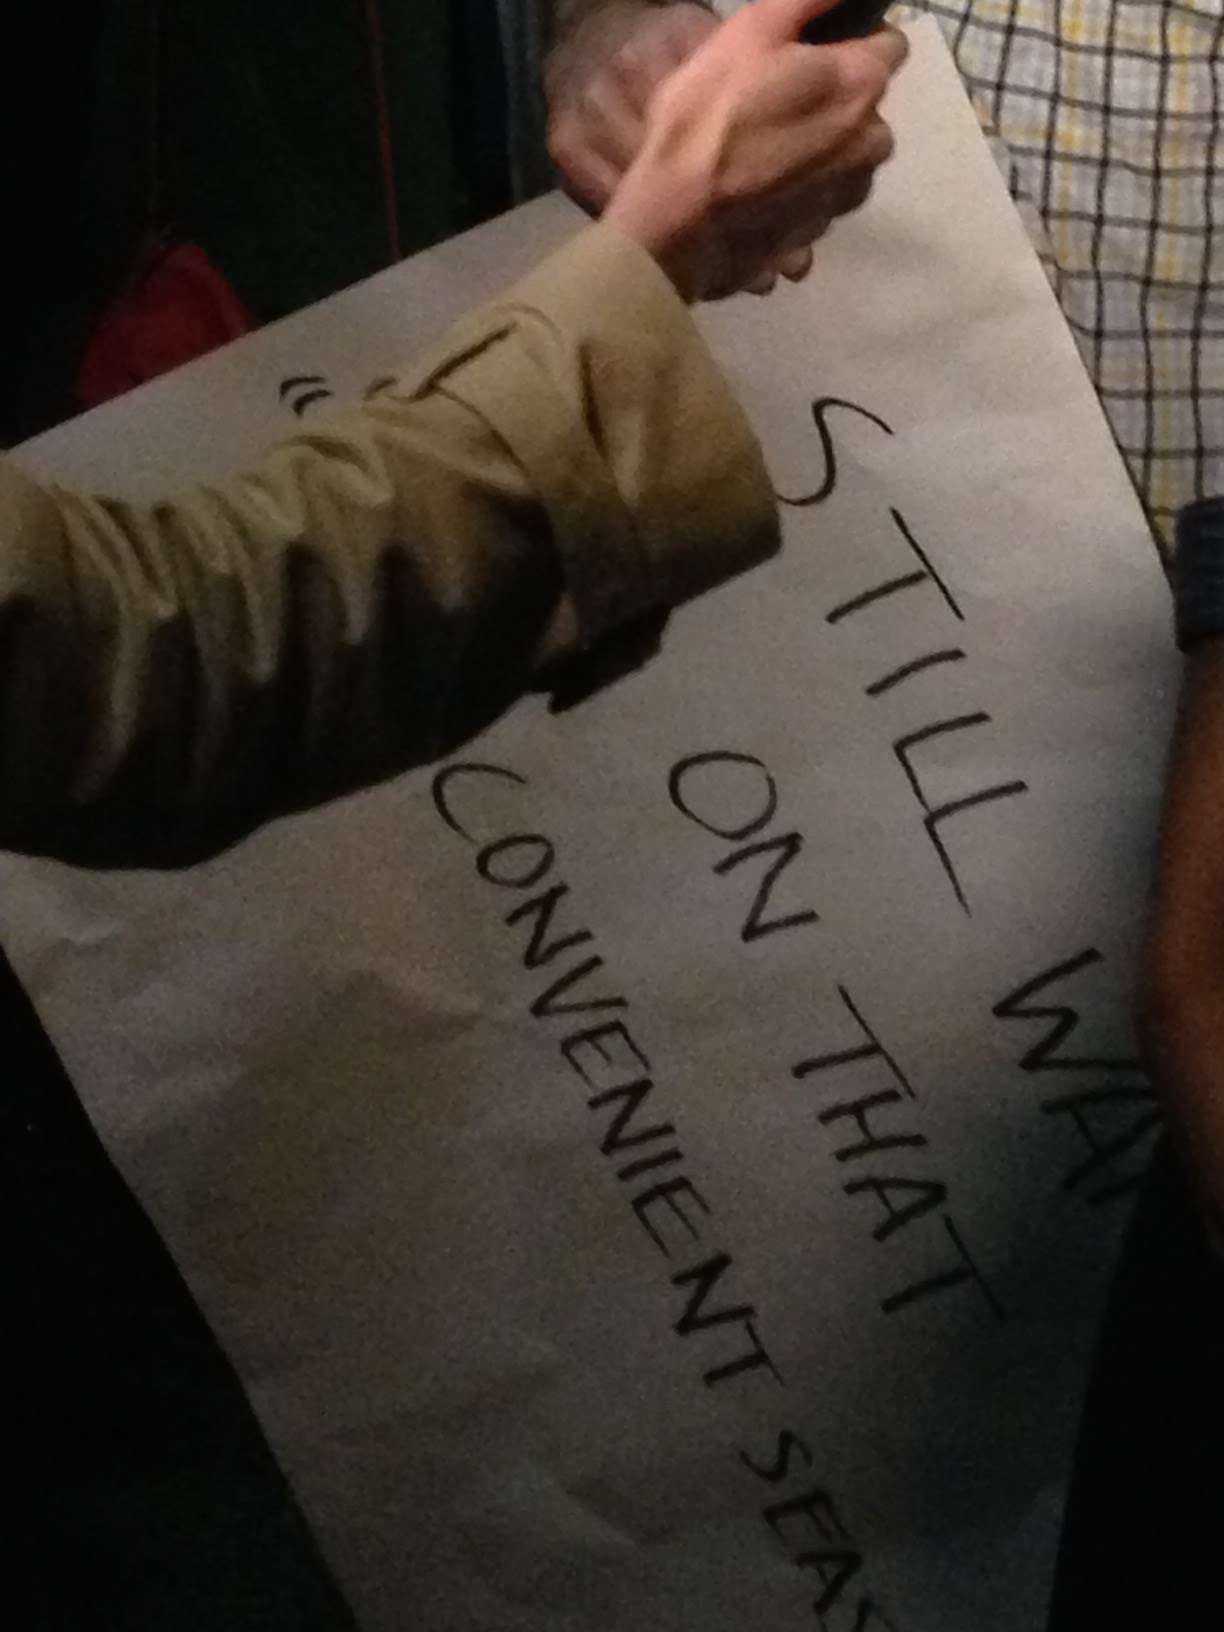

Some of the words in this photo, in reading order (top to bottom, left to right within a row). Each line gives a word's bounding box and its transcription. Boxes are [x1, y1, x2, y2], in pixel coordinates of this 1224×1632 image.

[774, 396, 1028, 919] STILL
[431, 763, 785, 1386] CONVENIENT
[668, 750, 820, 942] ON
[792, 984, 1004, 1320] THAT
